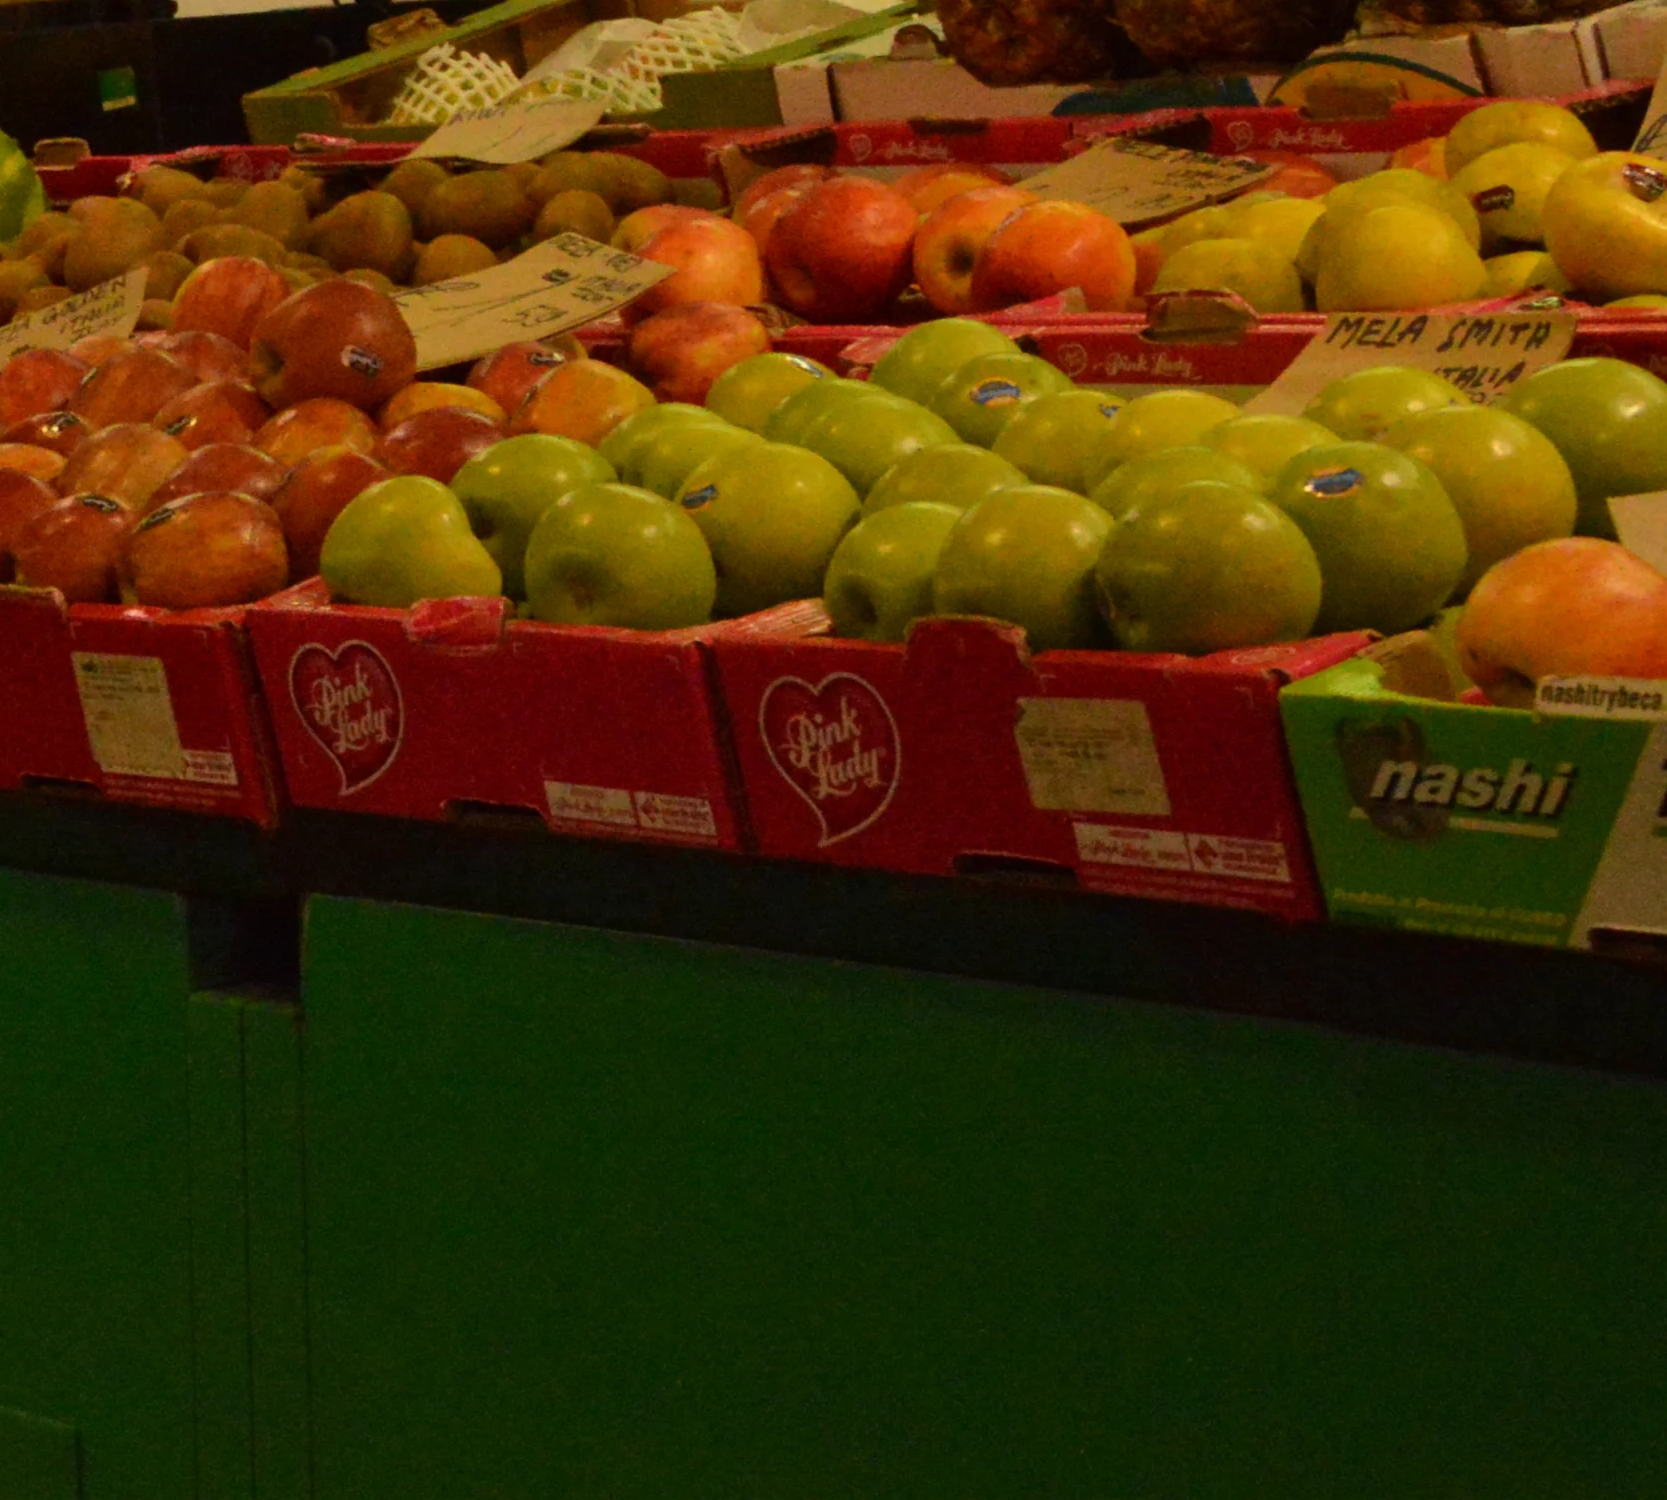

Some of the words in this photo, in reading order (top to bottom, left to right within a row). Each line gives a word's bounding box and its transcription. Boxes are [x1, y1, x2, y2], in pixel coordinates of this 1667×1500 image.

[1324, 314, 1431, 350] MELA
[1434, 315, 1554, 354] SMITH
[305, 662, 372, 726] Pink
[331, 700, 394, 754] Lady
[779, 694, 864, 768] Pink
[809, 739, 884, 800] Lady
[1369, 757, 1577, 819] nashi
